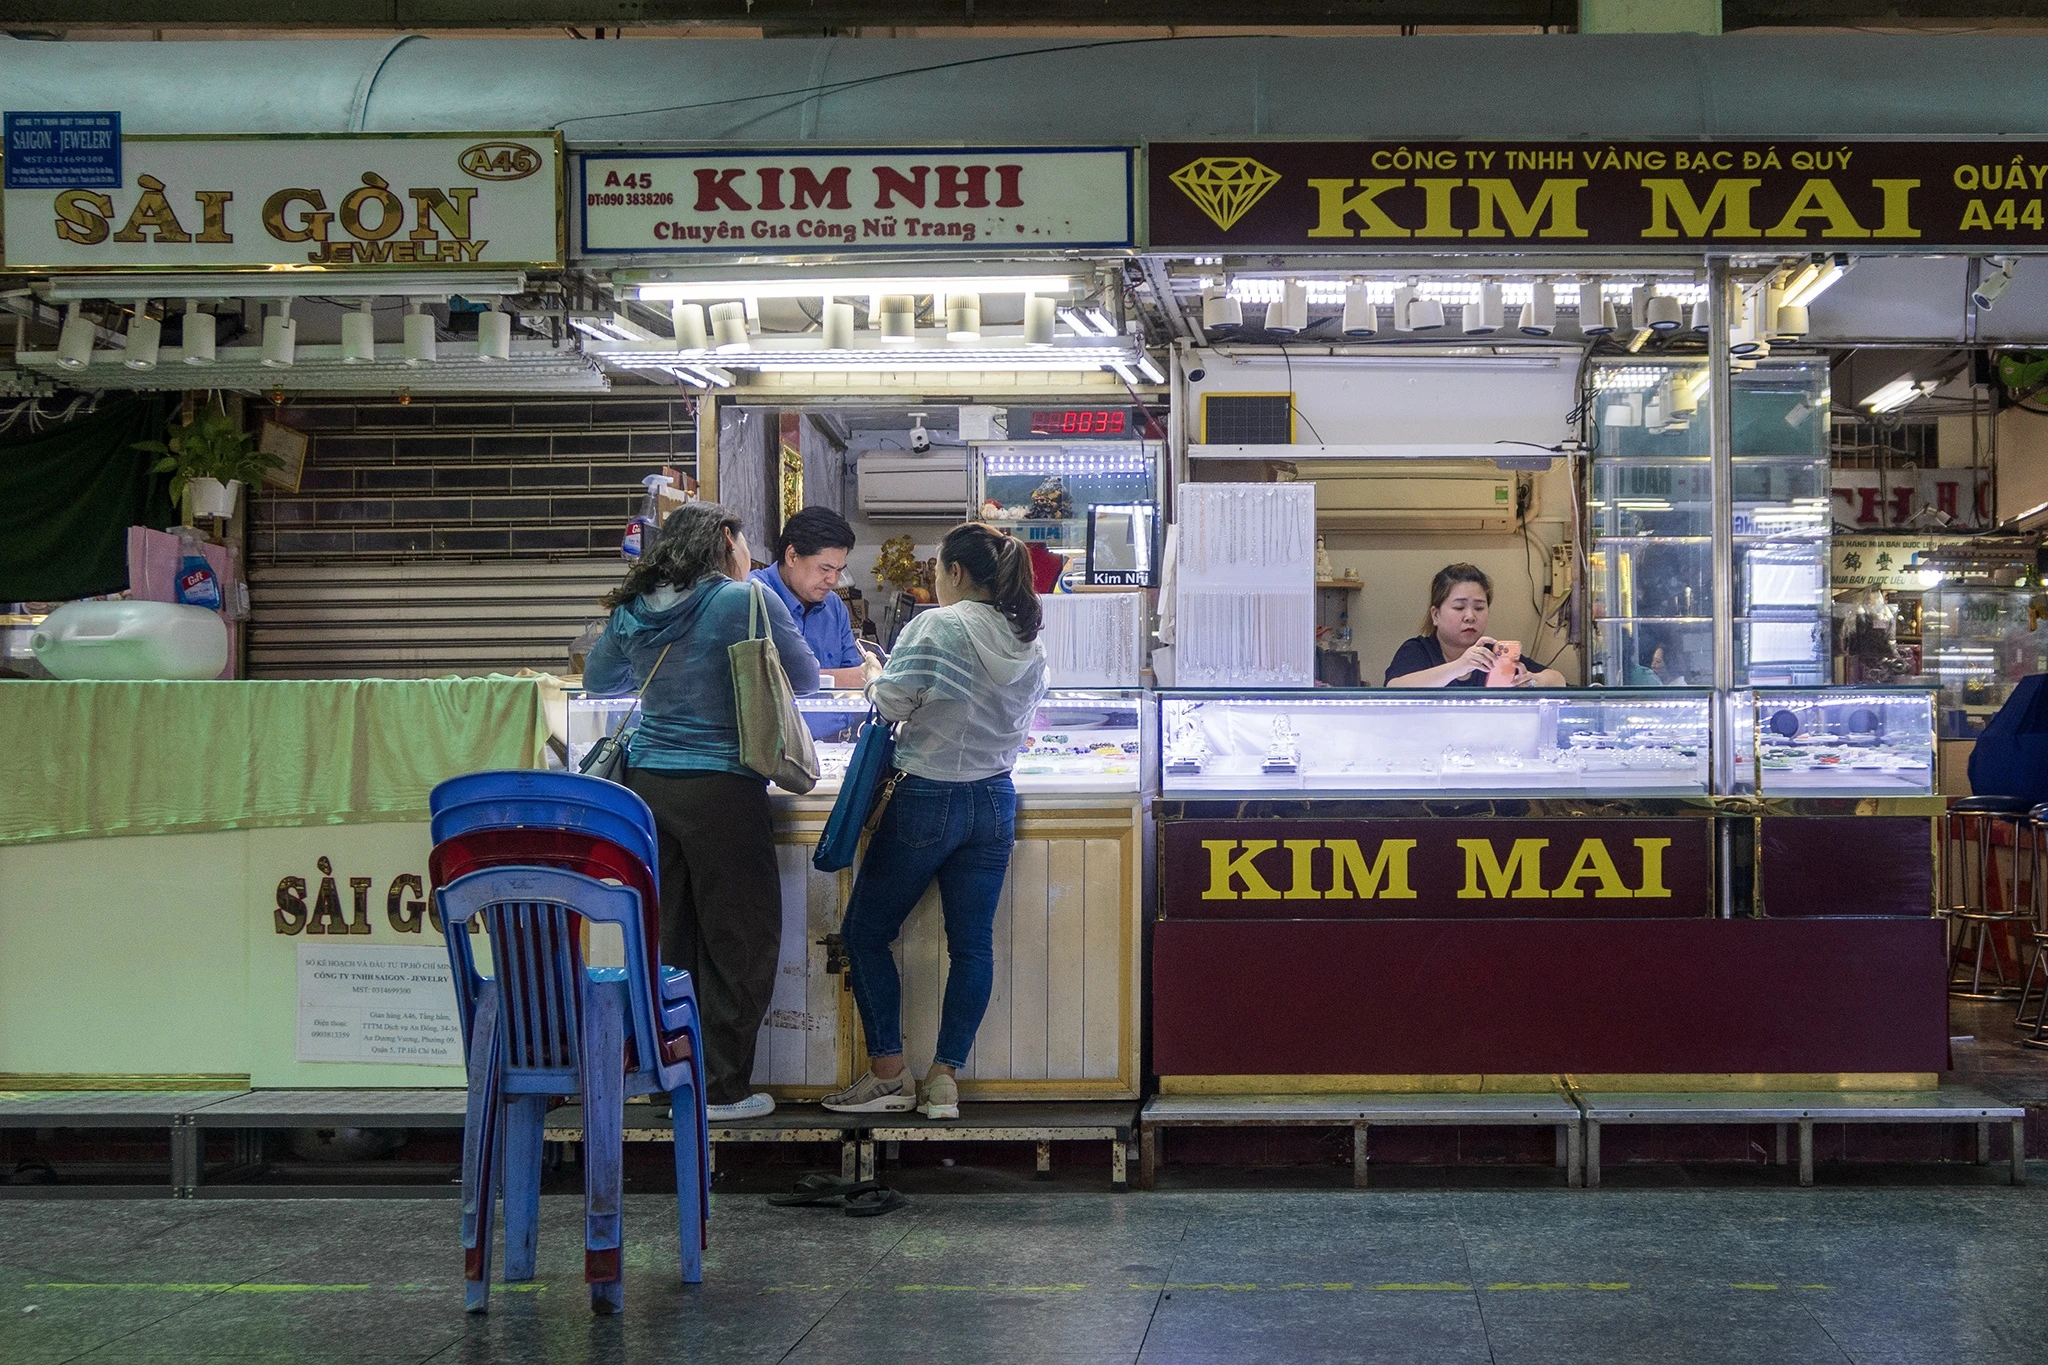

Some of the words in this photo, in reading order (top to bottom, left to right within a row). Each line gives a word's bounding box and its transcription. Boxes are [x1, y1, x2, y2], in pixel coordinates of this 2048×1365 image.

[13, 131, 52, 149] SAIGON
[469, 150, 532, 173] A46
[1371, 146, 1458, 170] CÔNG
[1465, 150, 1496, 169] TY
[1505, 150, 1574, 169] TNHH
[1583, 146, 1667, 170] VÀNG
[1675, 150, 1734, 174] BẠC
[1743, 146, 1782, 170] ĐÁ
[1791, 146, 1853, 170] QUÝ
[1953, 154, 2048, 190] QUẦY
[604, 171, 652, 189] A45
[693, 167, 852, 211] KIM
[872, 165, 1024, 209] NHI
[54, 174, 233, 245] SÀI
[262, 171, 478, 242] GÒN
[1308, 178, 1588, 237] KIM
[1641, 178, 1921, 237] MAI
[1959, 199, 2045, 230] A44
[653, 220, 745, 243] Chuyên
[751, 220, 791, 239] Gia
[796, 219, 857, 243] Công
[862, 216, 897, 238] Nữ
[904, 217, 976, 241] Trang
[308, 240, 489, 263] JEWELRY
[1094, 573, 1121, 584] Kim
[1202, 839, 1417, 899] KIM
[1457, 838, 1672, 898] MAI
[274, 856, 372, 935] SÀI
[314, 971, 337, 980] CÔNG
[339, 972, 350, 980] TY
